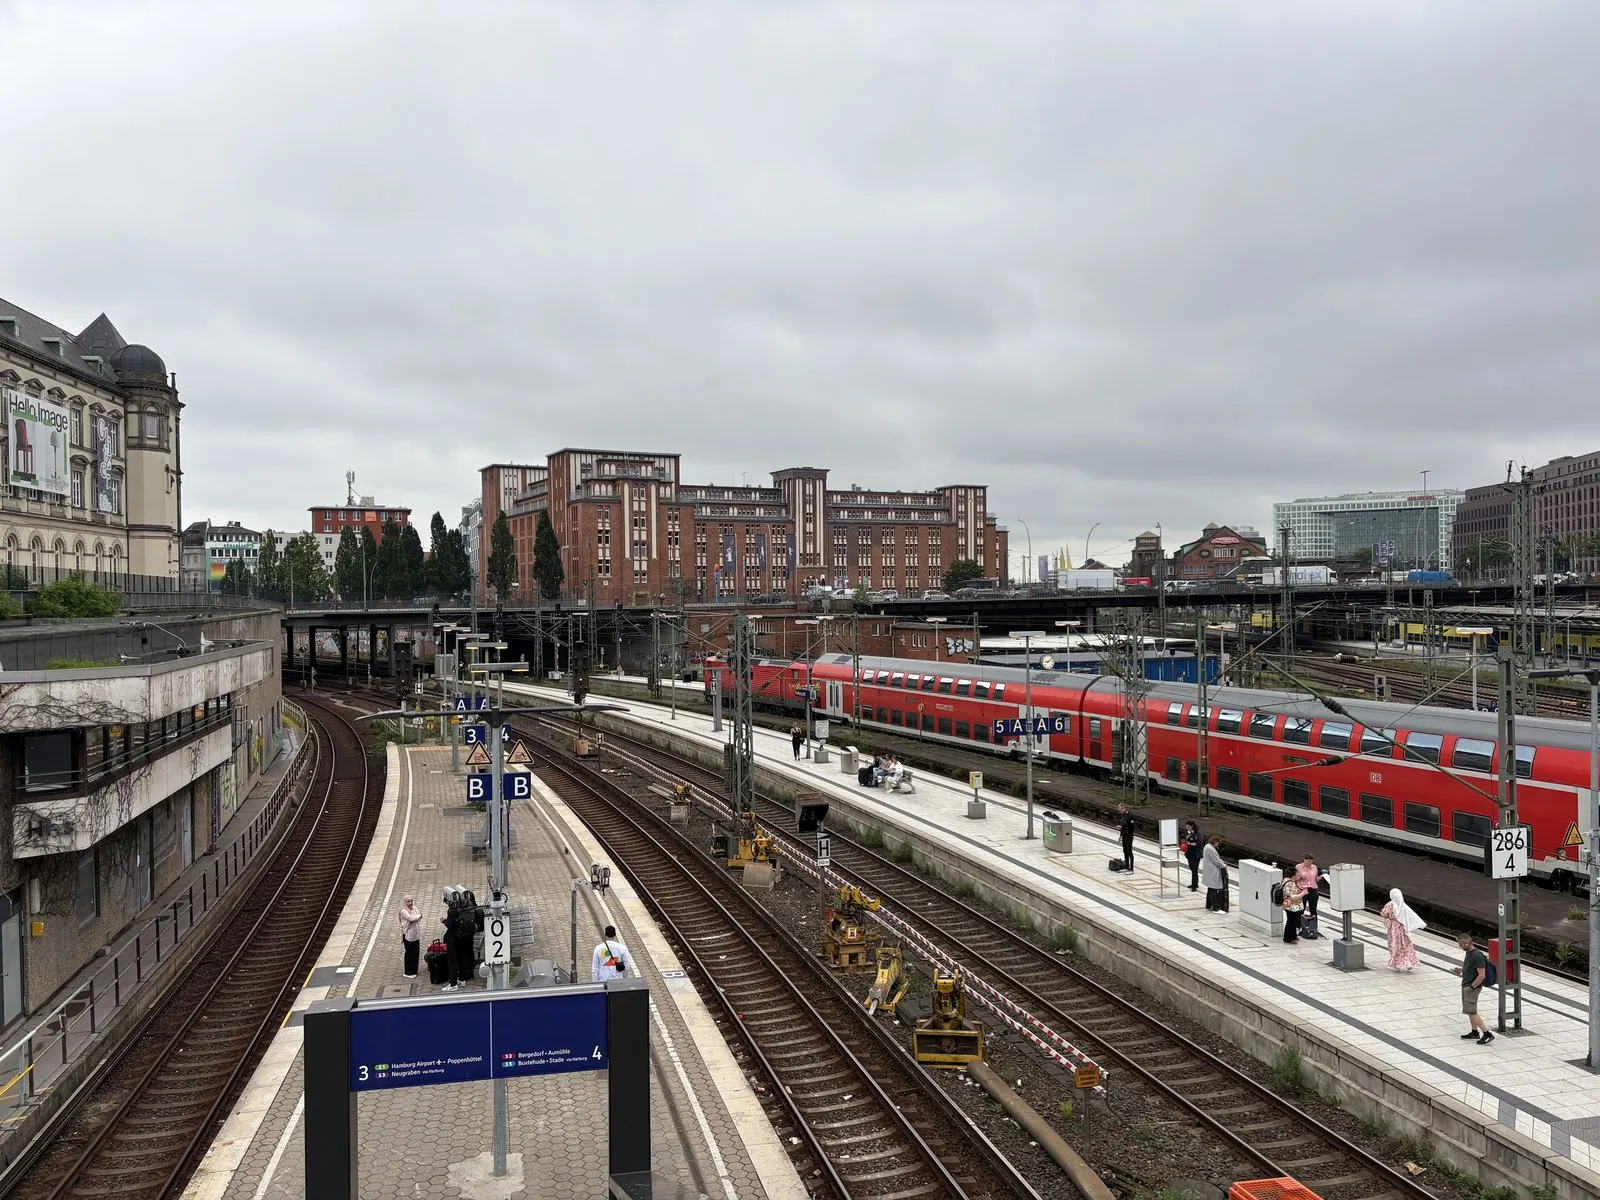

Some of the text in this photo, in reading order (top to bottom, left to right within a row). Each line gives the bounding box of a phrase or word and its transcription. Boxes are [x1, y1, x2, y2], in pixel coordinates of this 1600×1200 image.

[9, 393, 68, 432] Hello Image
[457, 699, 466, 710] A
[996, 718, 1063, 733] 5 A A 6
[467, 727, 509, 743] 3 4
[1181, 761, 1186, 769] 2
[469, 778, 484, 798] B
[514, 777, 528, 797] B
[819, 840, 829, 856] H
[1493, 830, 1524, 851] 286
[1505, 853, 1515, 871] 4
[491, 920, 504, 937] 0
[492, 941, 503, 958] 2
[518, 1050, 544, 1059] Bergedorf
[548, 1048, 571, 1056] Aumühle
[592, 1045, 602, 1060] 4
[391, 1061, 416, 1070] Hamburg
[416, 1059, 436, 1068] Airport
[447, 1056, 482, 1065] Poppenbüttel
[359, 1065, 369, 1081] 3
